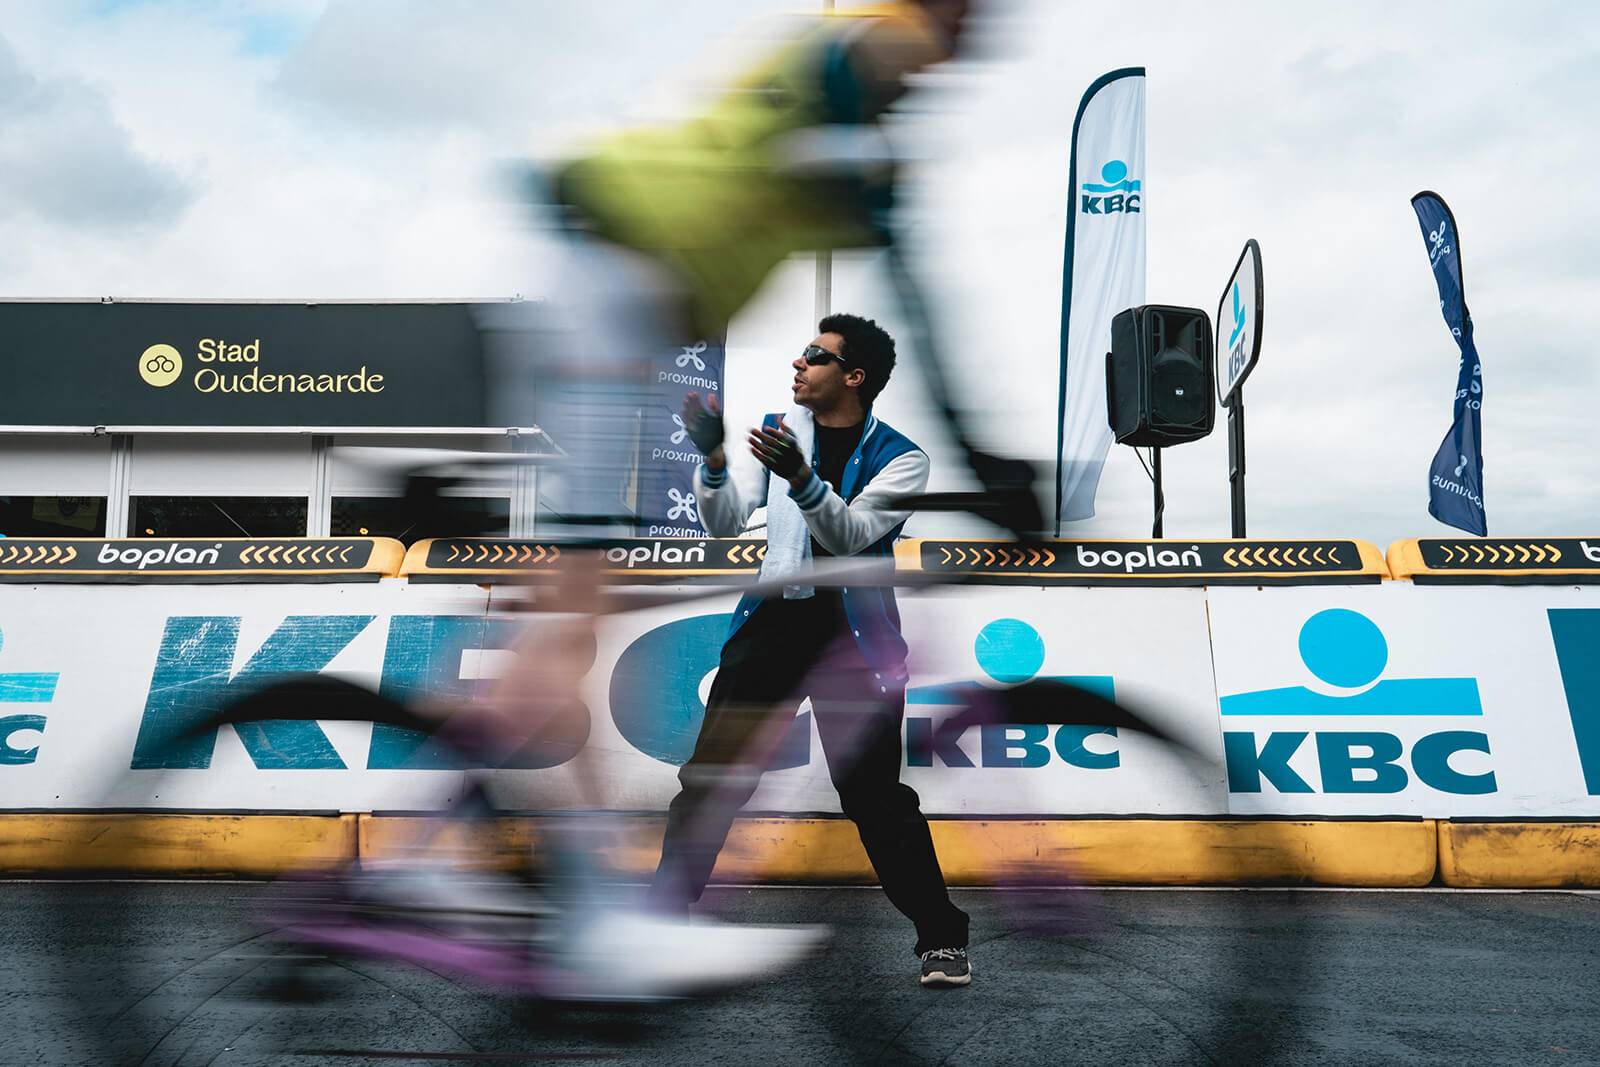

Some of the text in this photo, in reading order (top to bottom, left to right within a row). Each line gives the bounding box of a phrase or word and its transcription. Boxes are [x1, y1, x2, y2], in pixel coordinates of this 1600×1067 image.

[1082, 194, 1140, 214] KBC
[197, 339, 260, 363] Stad
[1229, 332, 1246, 386] KBC
[194, 366, 385, 394] Oudenaarde
[658, 371, 718, 390] proximus
[652, 448, 705, 464] proxim
[97, 543, 222, 570] boplan
[600, 541, 706, 568] oplan
[1077, 544, 1202, 572] boplan
[131, 615, 812, 770] KBC
[906, 717, 1121, 769] KBC
[1223, 730, 1498, 795] KBC
